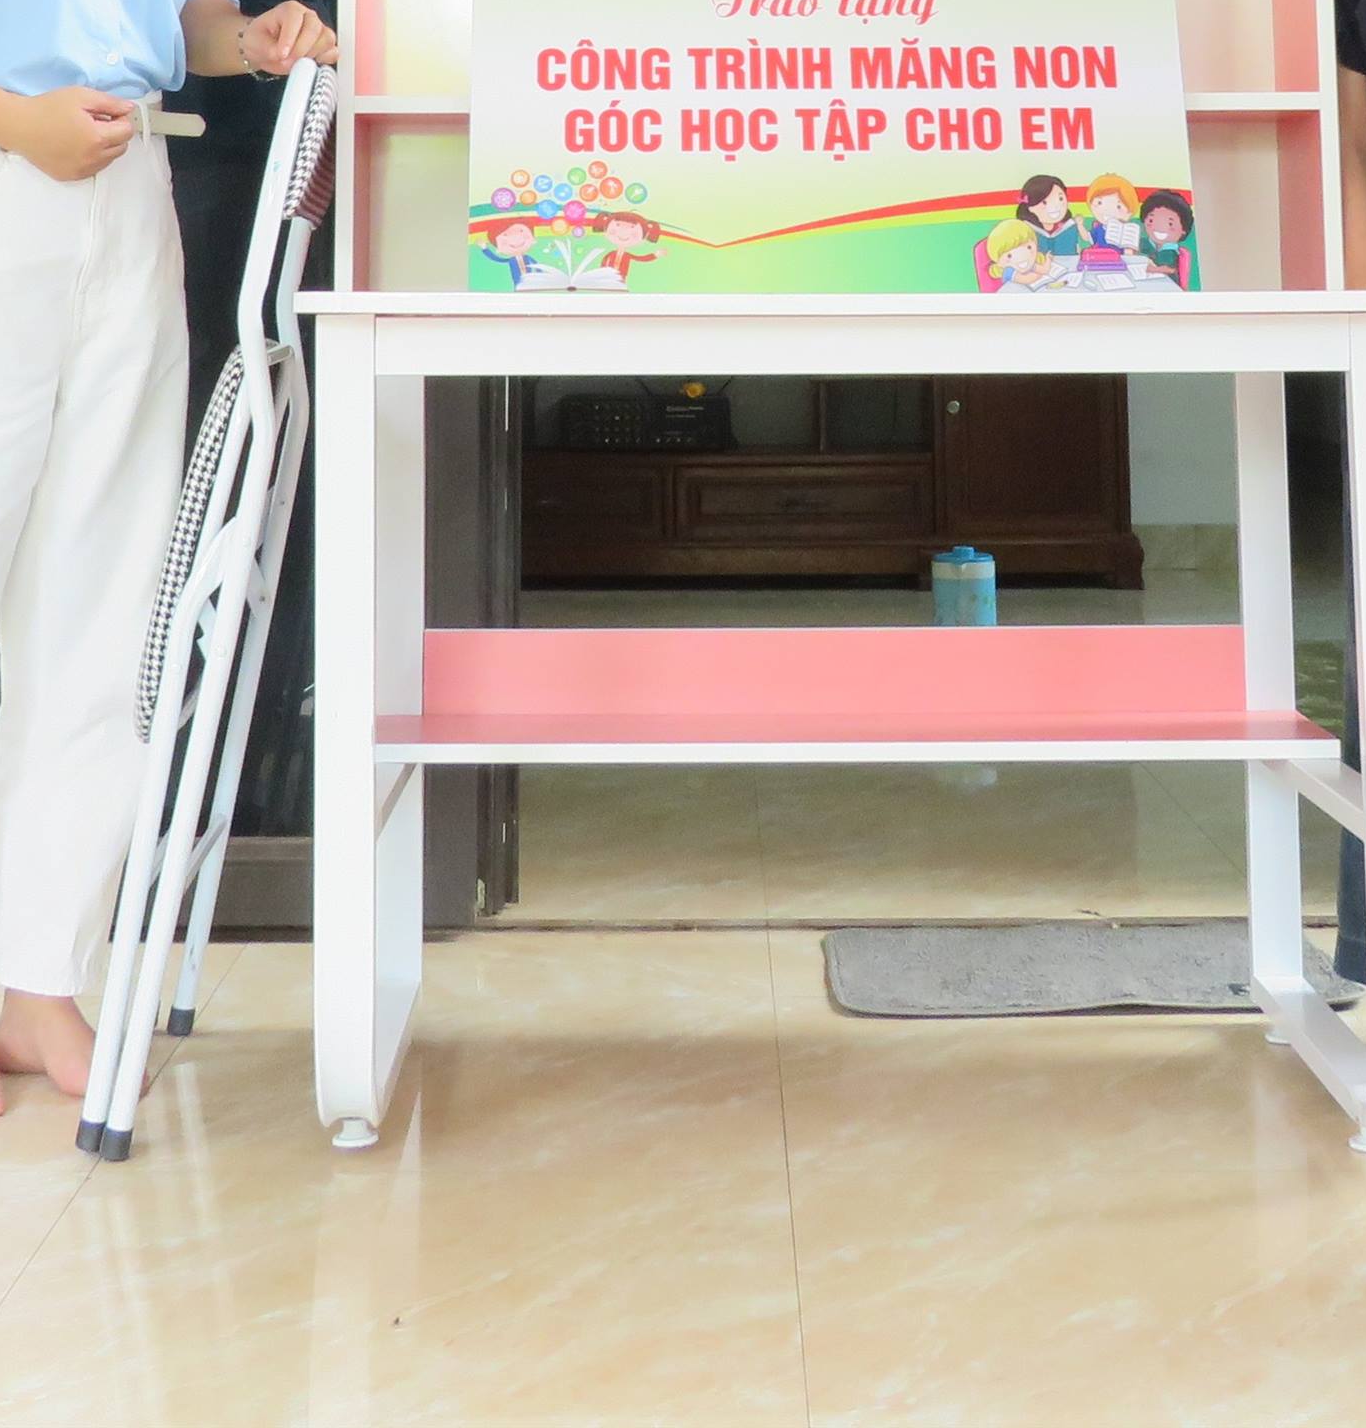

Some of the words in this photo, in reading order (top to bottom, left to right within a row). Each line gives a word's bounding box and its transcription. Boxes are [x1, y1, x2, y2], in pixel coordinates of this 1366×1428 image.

[536, 38, 671, 91] CÔNG
[687, 38, 832, 90] TRÌNH
[849, 37, 997, 89] MĂNG
[1013, 45, 1118, 89] NON
[564, 99, 662, 153] GÓC
[681, 108, 779, 162] HỌC
[794, 98, 887, 162] TẬP
[905, 107, 1003, 151] CHO
[1019, 107, 1095, 150] EM
